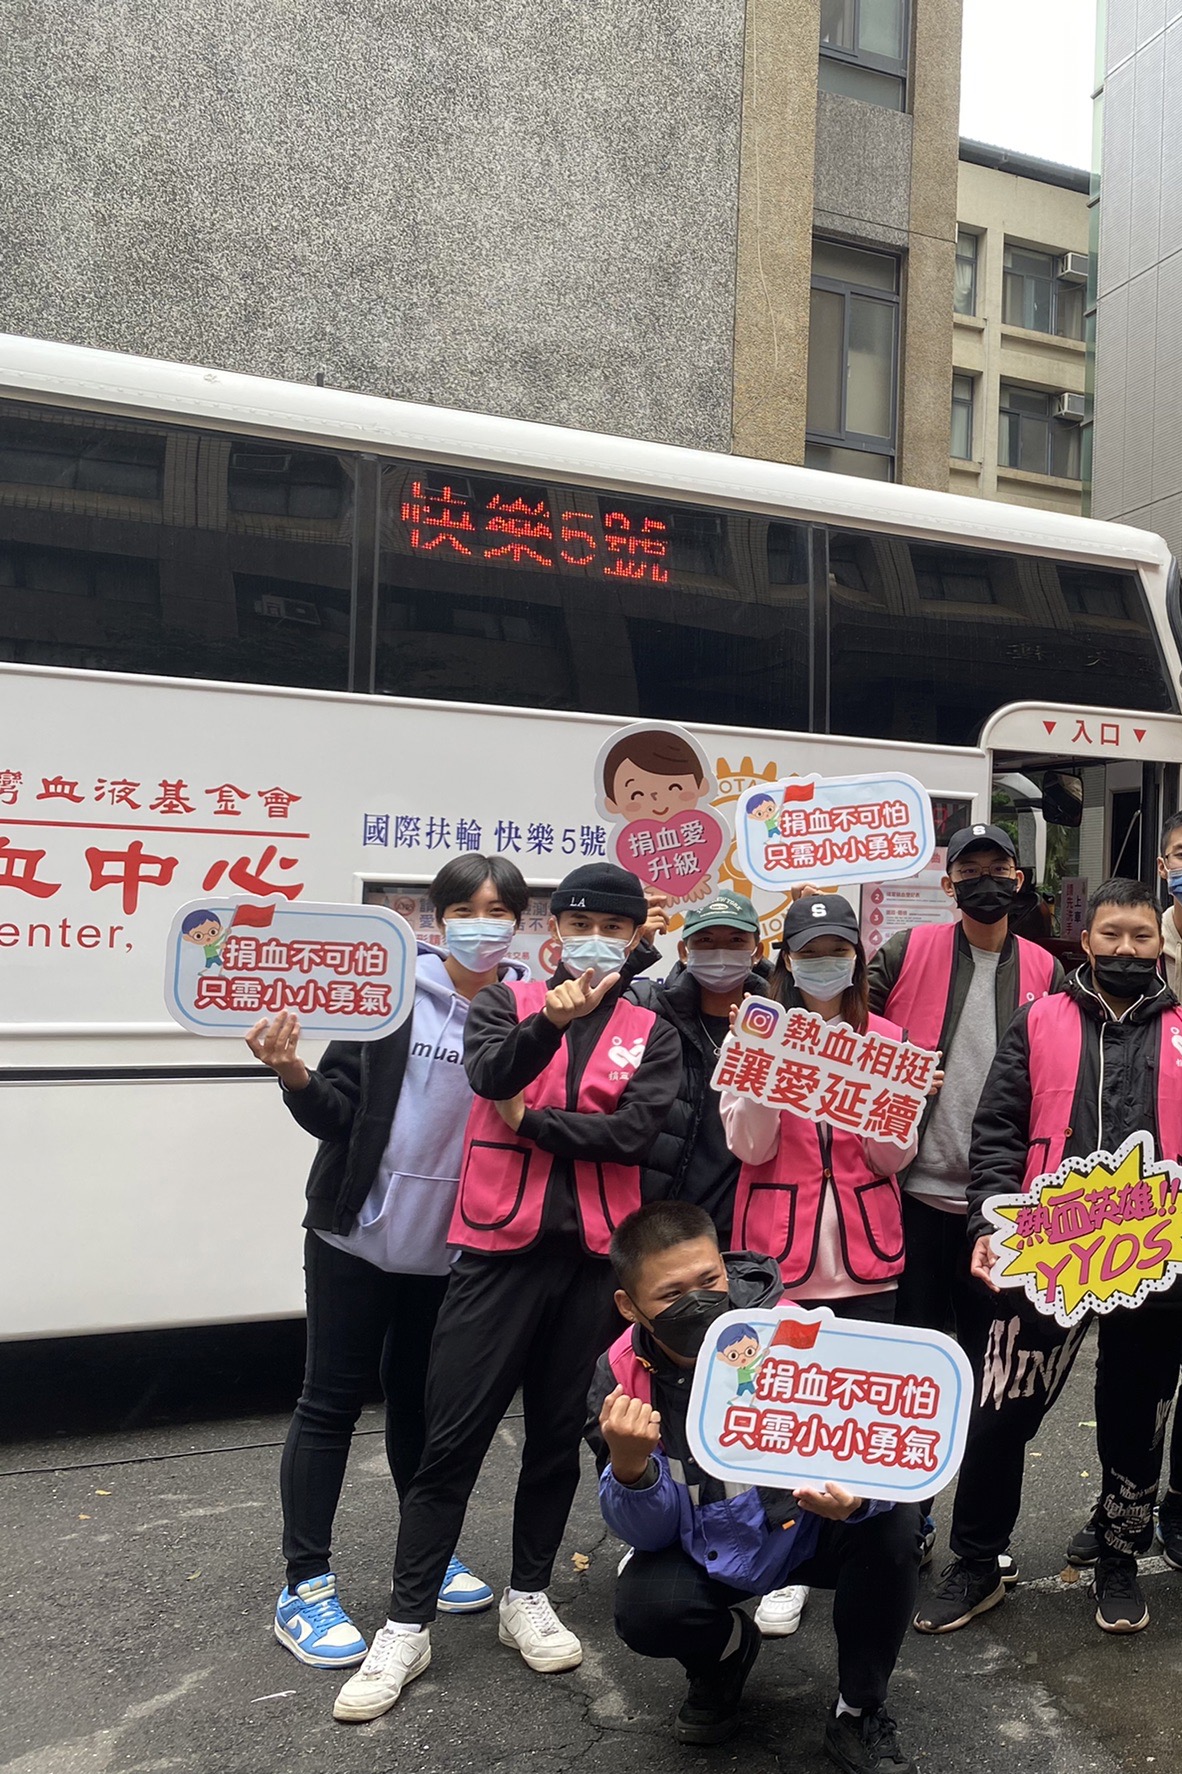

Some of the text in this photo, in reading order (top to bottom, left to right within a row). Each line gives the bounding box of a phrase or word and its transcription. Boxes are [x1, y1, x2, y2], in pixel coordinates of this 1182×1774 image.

[400, 481, 668, 583] 快樂5號
[1071, 720, 1119, 746] 入口
[362, 813, 607, 856] 國際扶輪 快樂5號
[782, 802, 909, 836] 捐血不可怕
[973, 825, 986, 836] S
[629, 820, 706, 857] 捐血愛
[765, 832, 917, 870] 只需小小勇氣
[648, 851, 701, 882] 升級
[570, 896, 586, 907] LA
[811, 903, 827, 917] S
[226, 938, 385, 974] 捐血不可怕
[198, 979, 389, 1014] 只需小小勇氣
[781, 1013, 934, 1090] 熱血相挺
[717, 1042, 921, 1144] 讓愛延續
[1016, 1177, 1181, 1249] 熱血英雄!!
[1036, 1219, 1172, 1303] YYDS
[760, 1361, 937, 1416] 捐血不可怕
[723, 1409, 937, 1467] 只需小小勇氣
